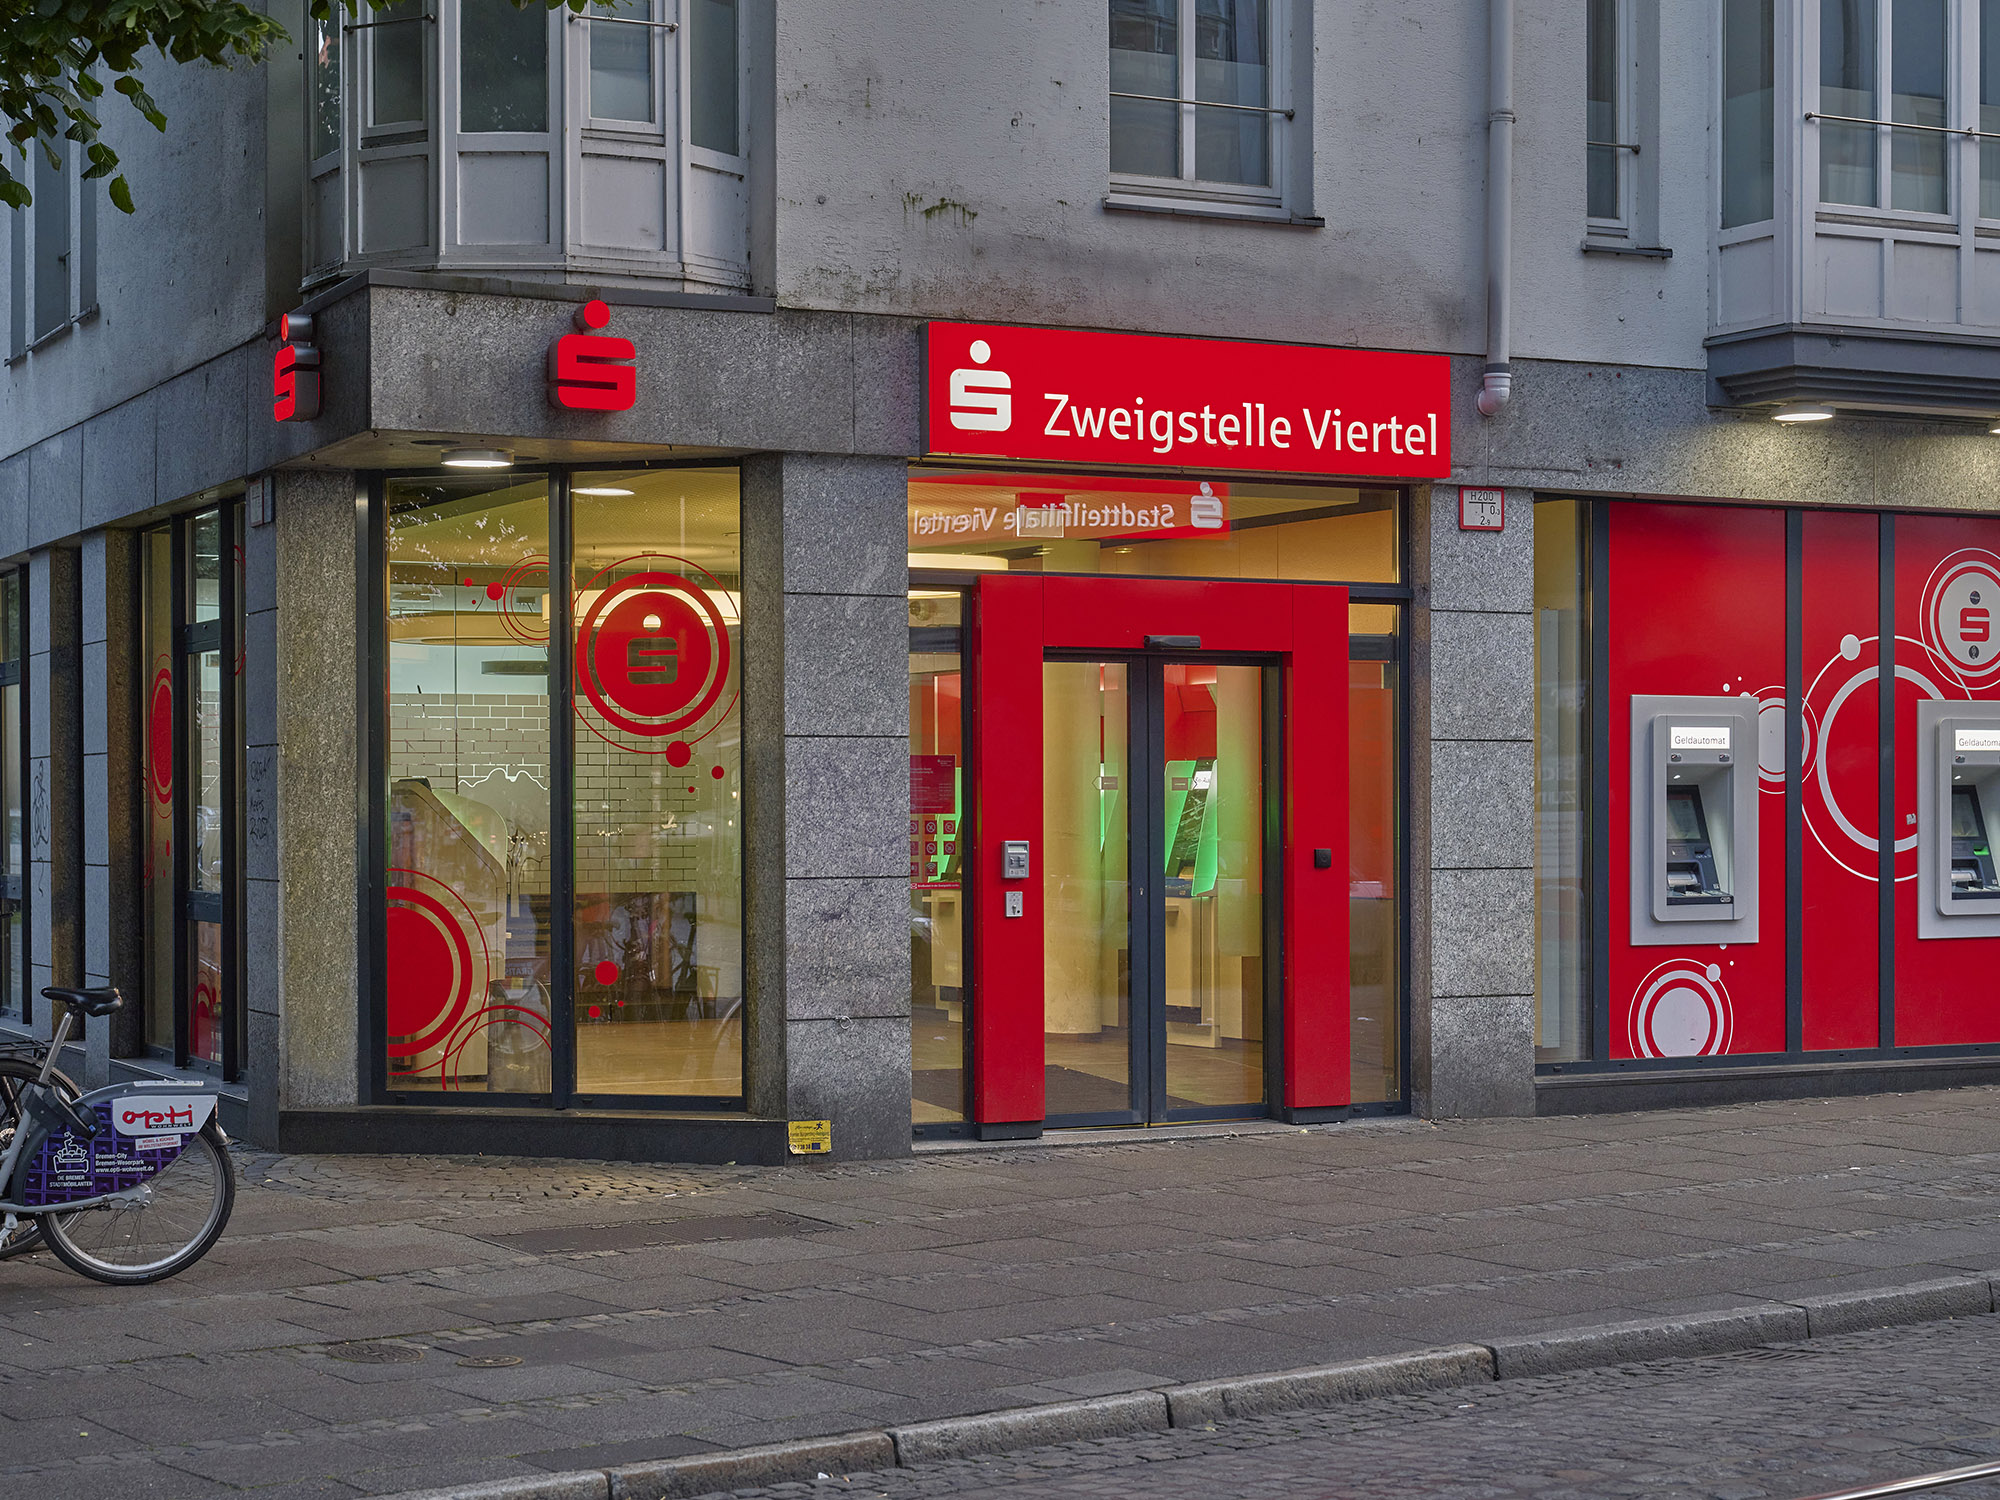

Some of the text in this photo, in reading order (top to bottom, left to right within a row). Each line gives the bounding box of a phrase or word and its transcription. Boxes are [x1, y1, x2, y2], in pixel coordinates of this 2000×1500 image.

[1043, 393, 1292, 454] Zweigstelle
[1302, 407, 1437, 456] Viertel
[1470, 491, 1494, 501] H200
[1674, 735, 1726, 745] Geldautomat
[122, 1104, 192, 1129] opti
